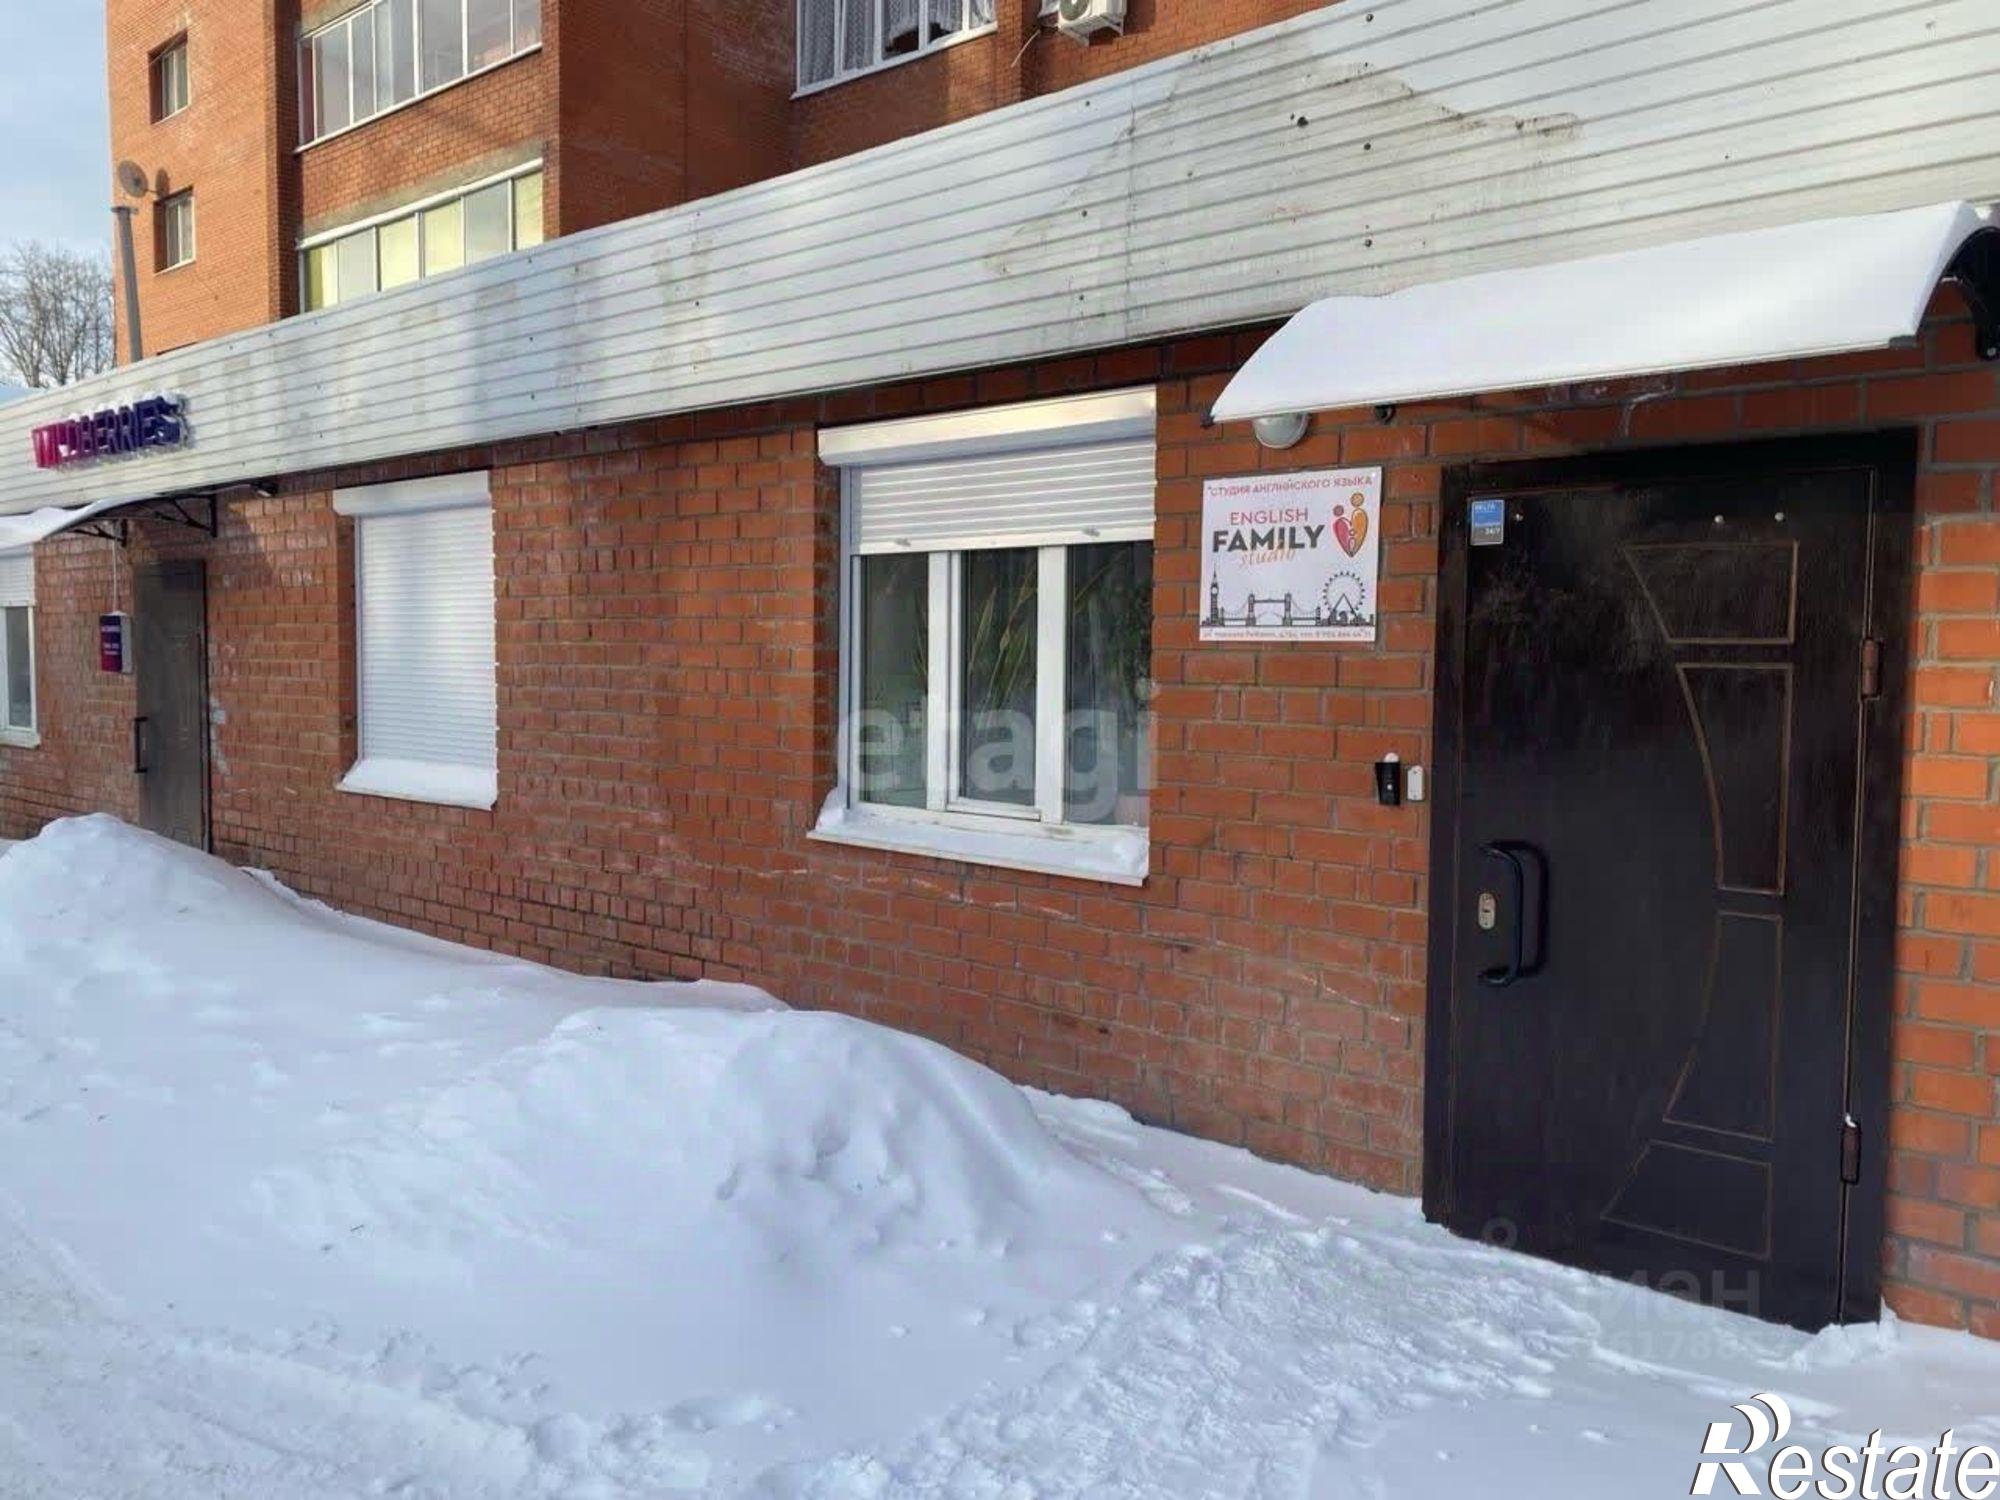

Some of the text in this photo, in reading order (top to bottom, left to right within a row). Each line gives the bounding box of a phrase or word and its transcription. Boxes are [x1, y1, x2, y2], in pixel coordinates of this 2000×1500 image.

[1210, 474, 1373, 498] СТУДИЯ АНГЛИЙСКОГО ЯЗЫКА
[1230, 508, 1309, 527] ENGLISH
[1212, 524, 1326, 553] FAMILY
[1238, 541, 1297, 569] studio
